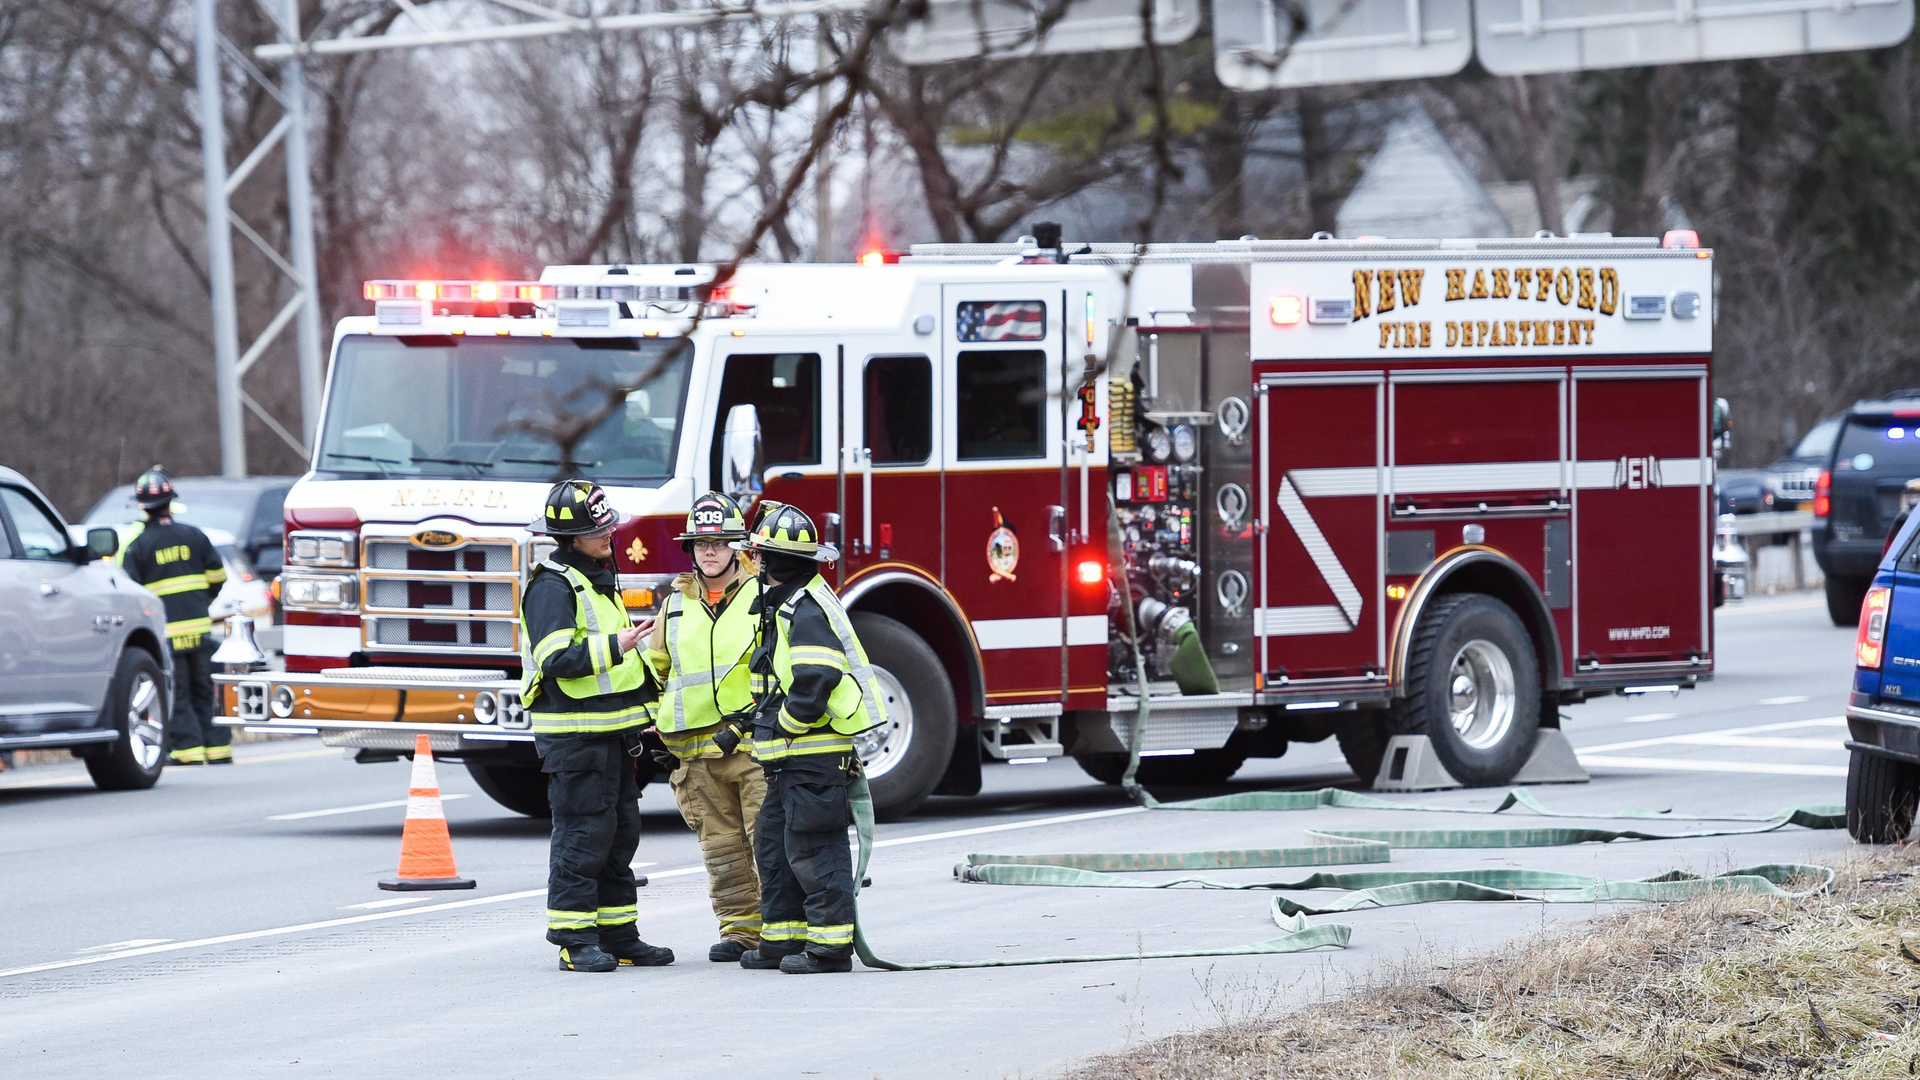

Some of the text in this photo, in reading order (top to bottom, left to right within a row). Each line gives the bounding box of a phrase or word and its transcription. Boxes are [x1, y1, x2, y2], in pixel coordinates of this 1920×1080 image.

[1352, 267, 1620, 322] NEW HARTFORD
[1379, 319, 1596, 349] FIRE DEPARTMENT
[695, 510, 724, 524] 309
